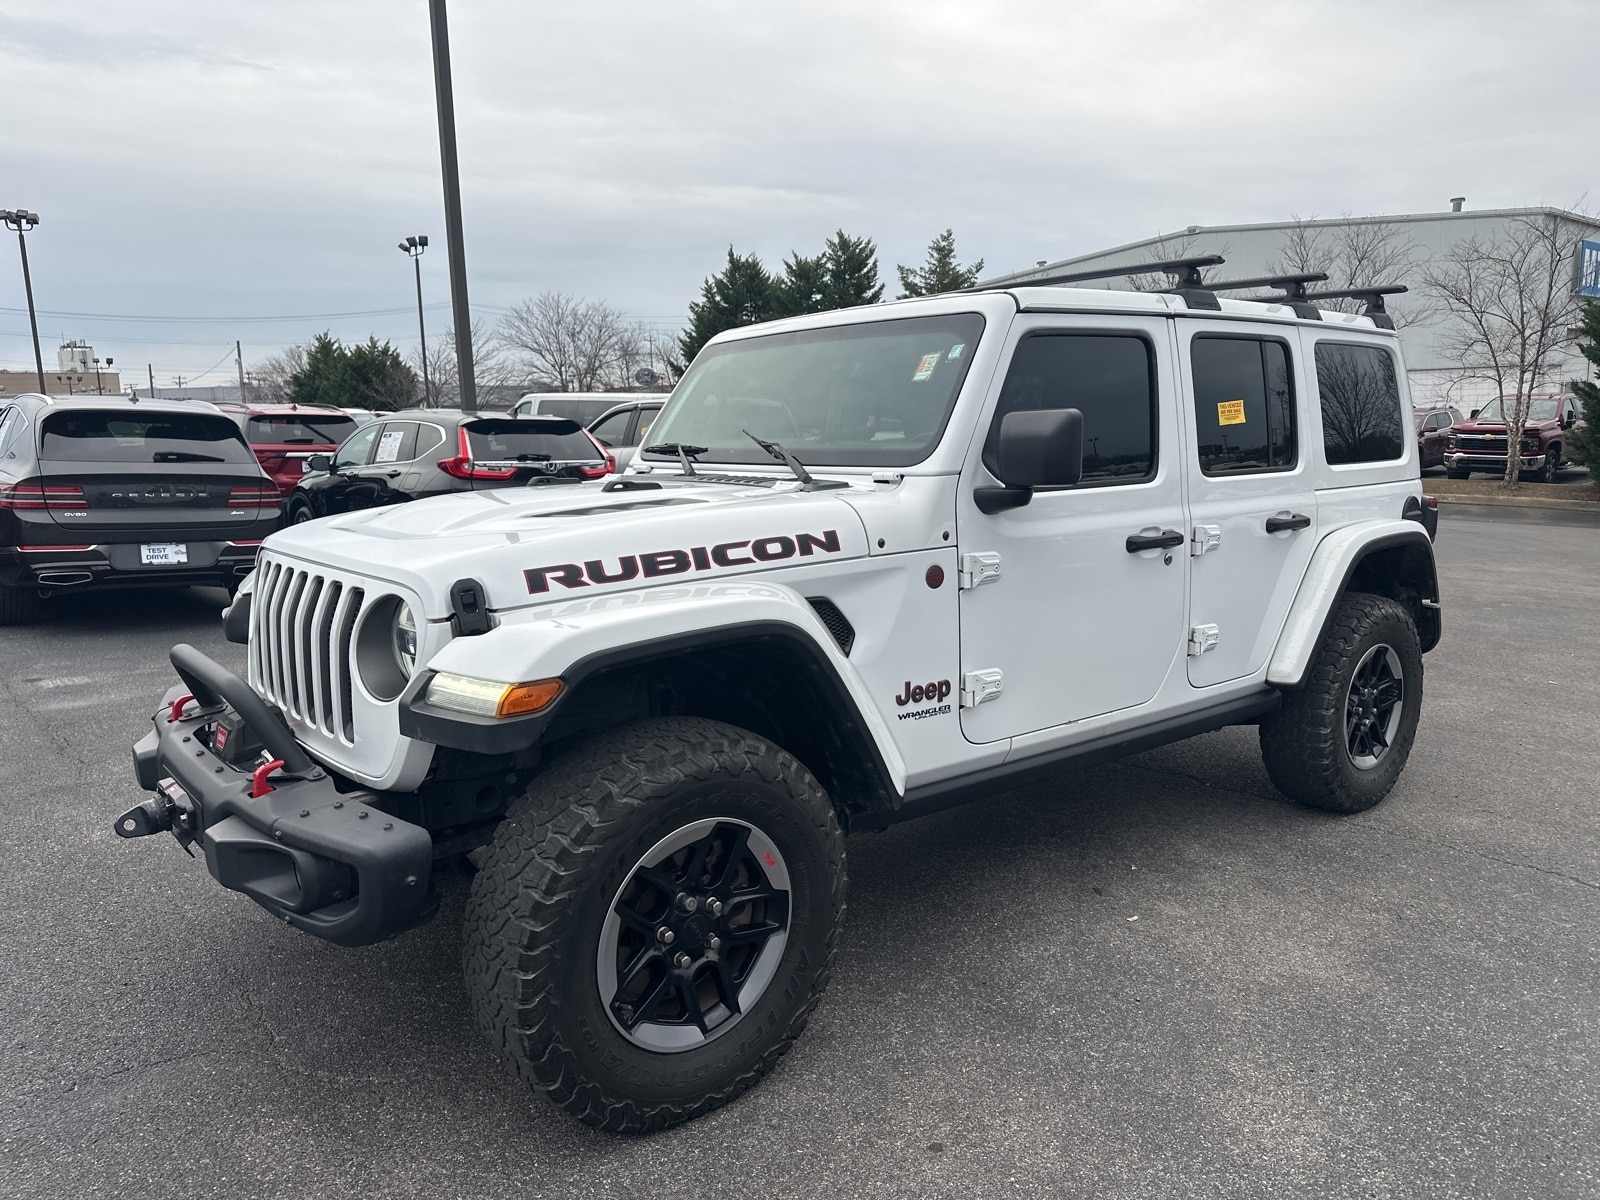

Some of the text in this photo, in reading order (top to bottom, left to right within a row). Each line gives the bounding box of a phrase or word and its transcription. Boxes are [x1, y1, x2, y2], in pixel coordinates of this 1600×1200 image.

[523, 530, 841, 594] RUBICON
[895, 679, 951, 706] Jeep
[897, 704, 951, 720] WRANGLER
